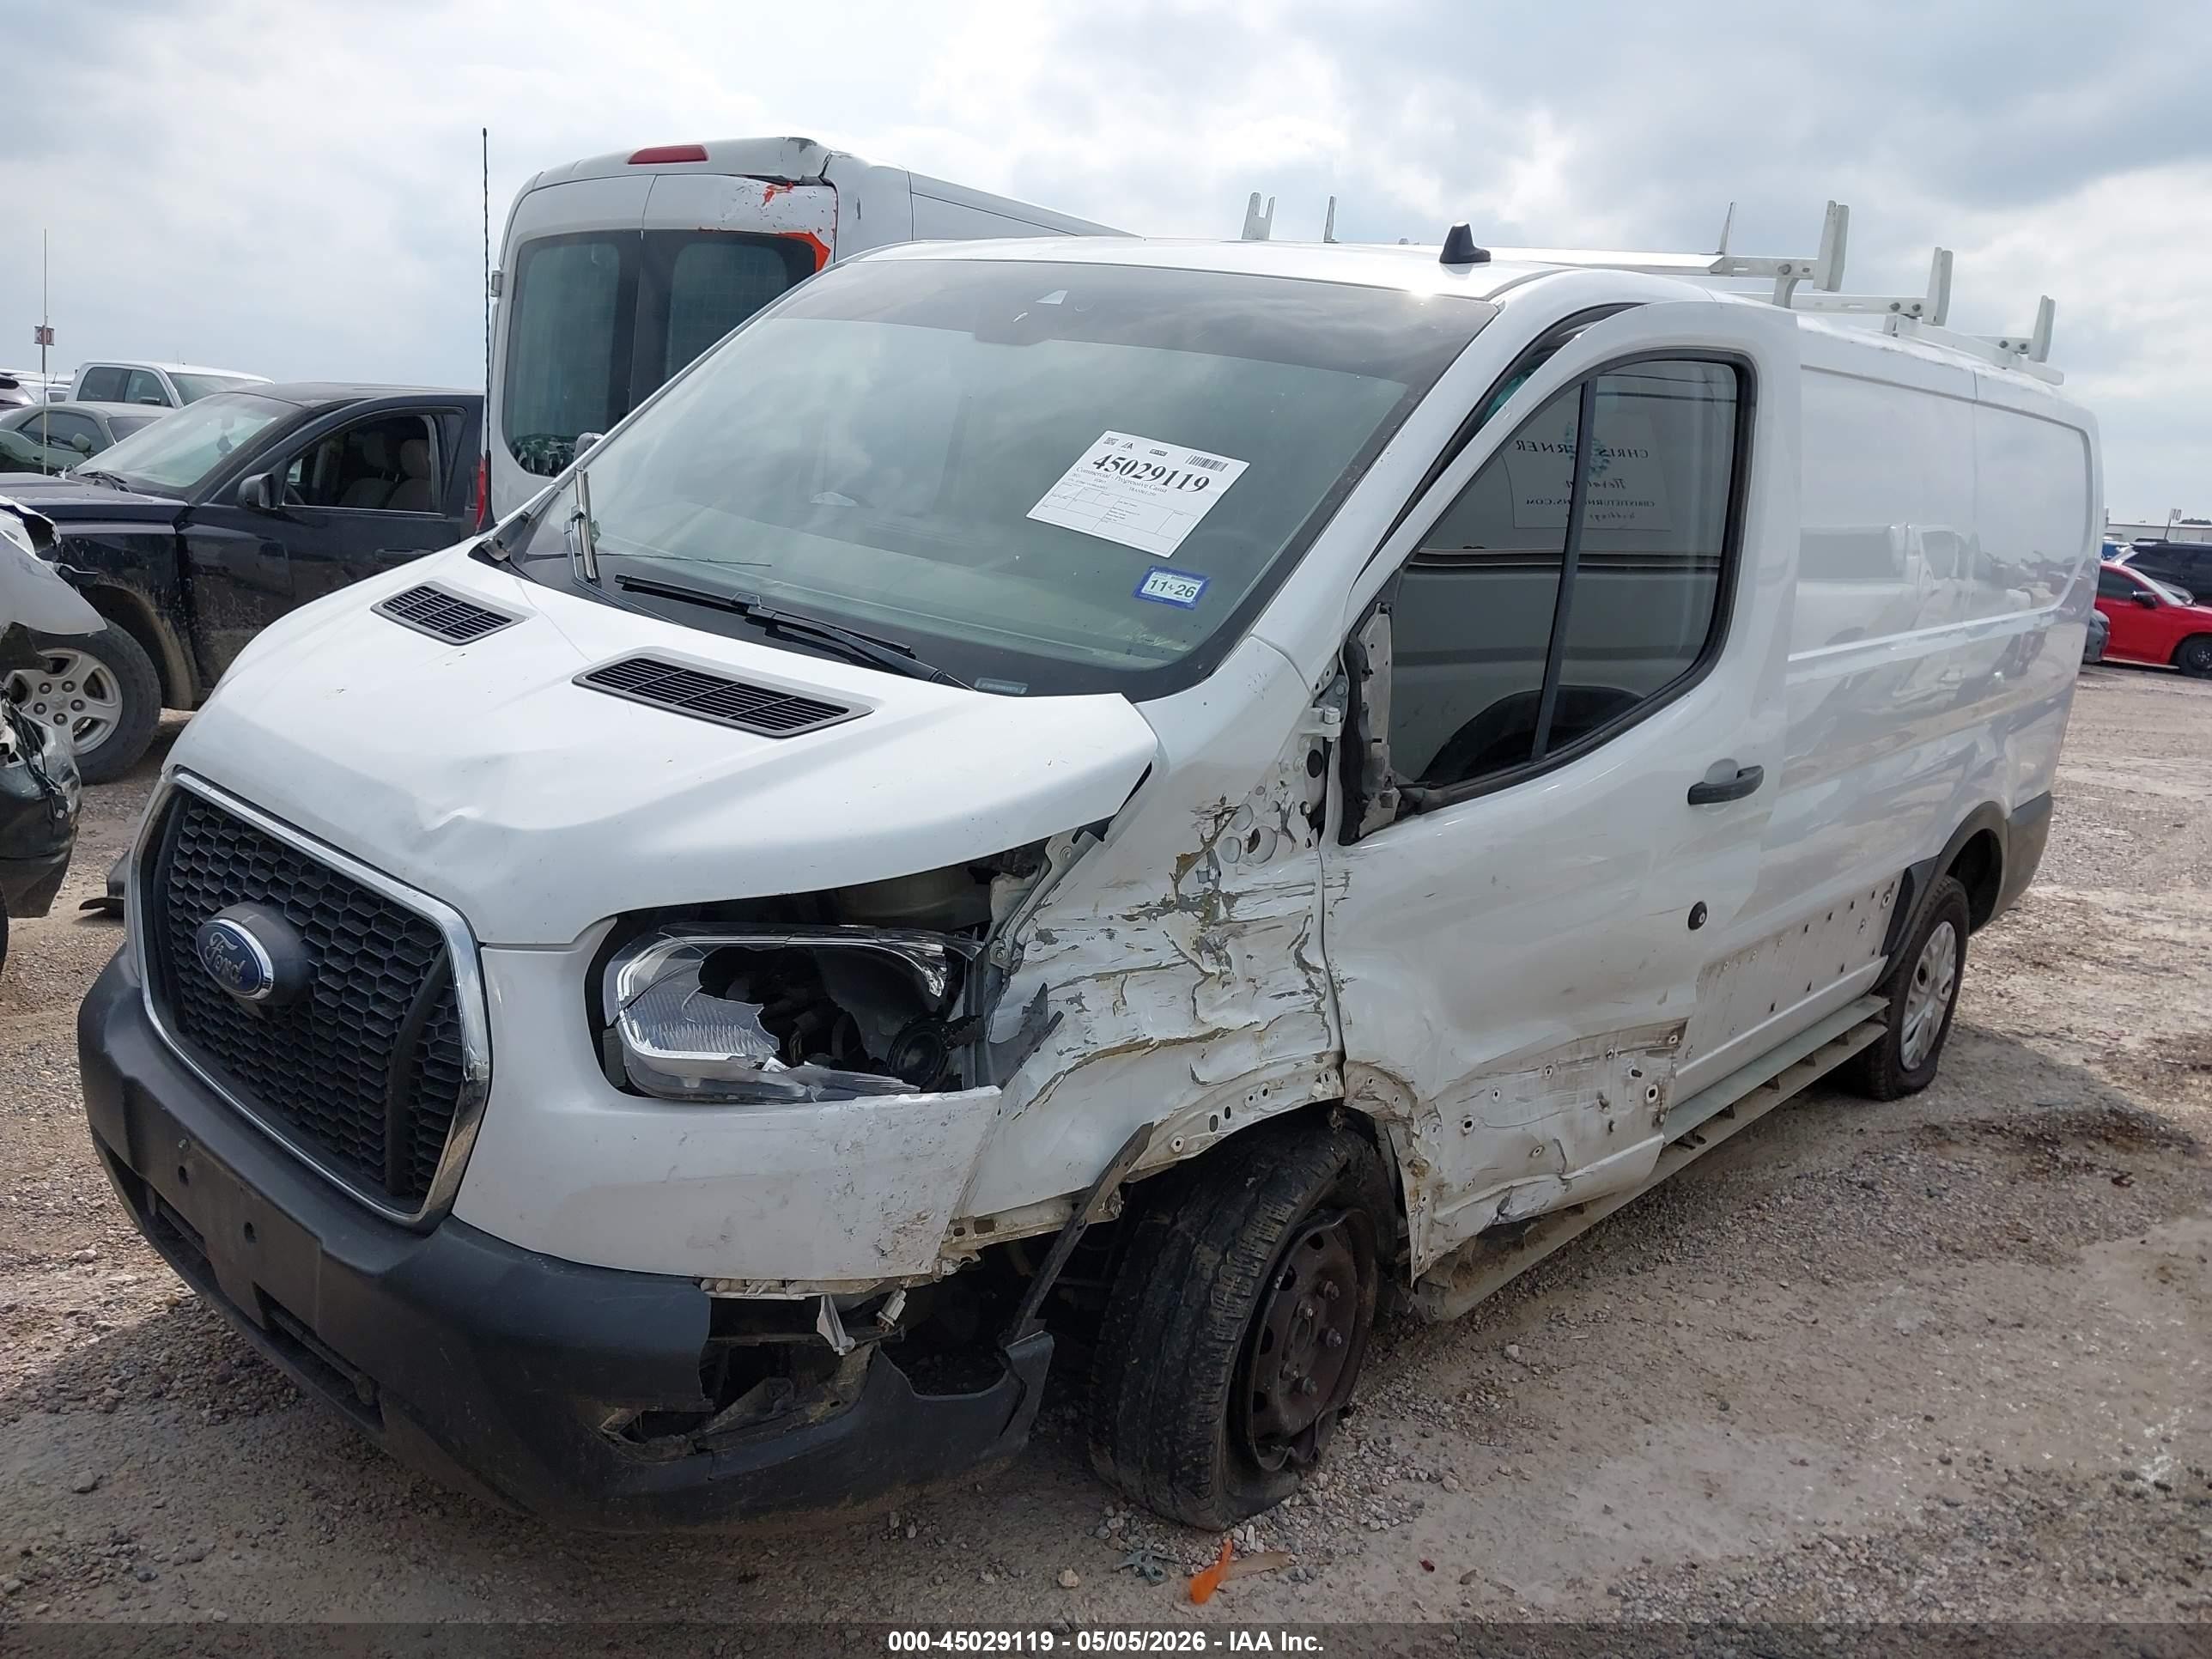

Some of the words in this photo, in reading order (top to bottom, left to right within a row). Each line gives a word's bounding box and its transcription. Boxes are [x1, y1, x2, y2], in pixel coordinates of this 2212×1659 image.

[1077, 466, 1111, 479] Commercial
[1092, 454, 1210, 493] 45029119
[1150, 579, 1169, 592] 11
[1174, 584, 1197, 598] 26
[204, 932, 246, 984] Ford
